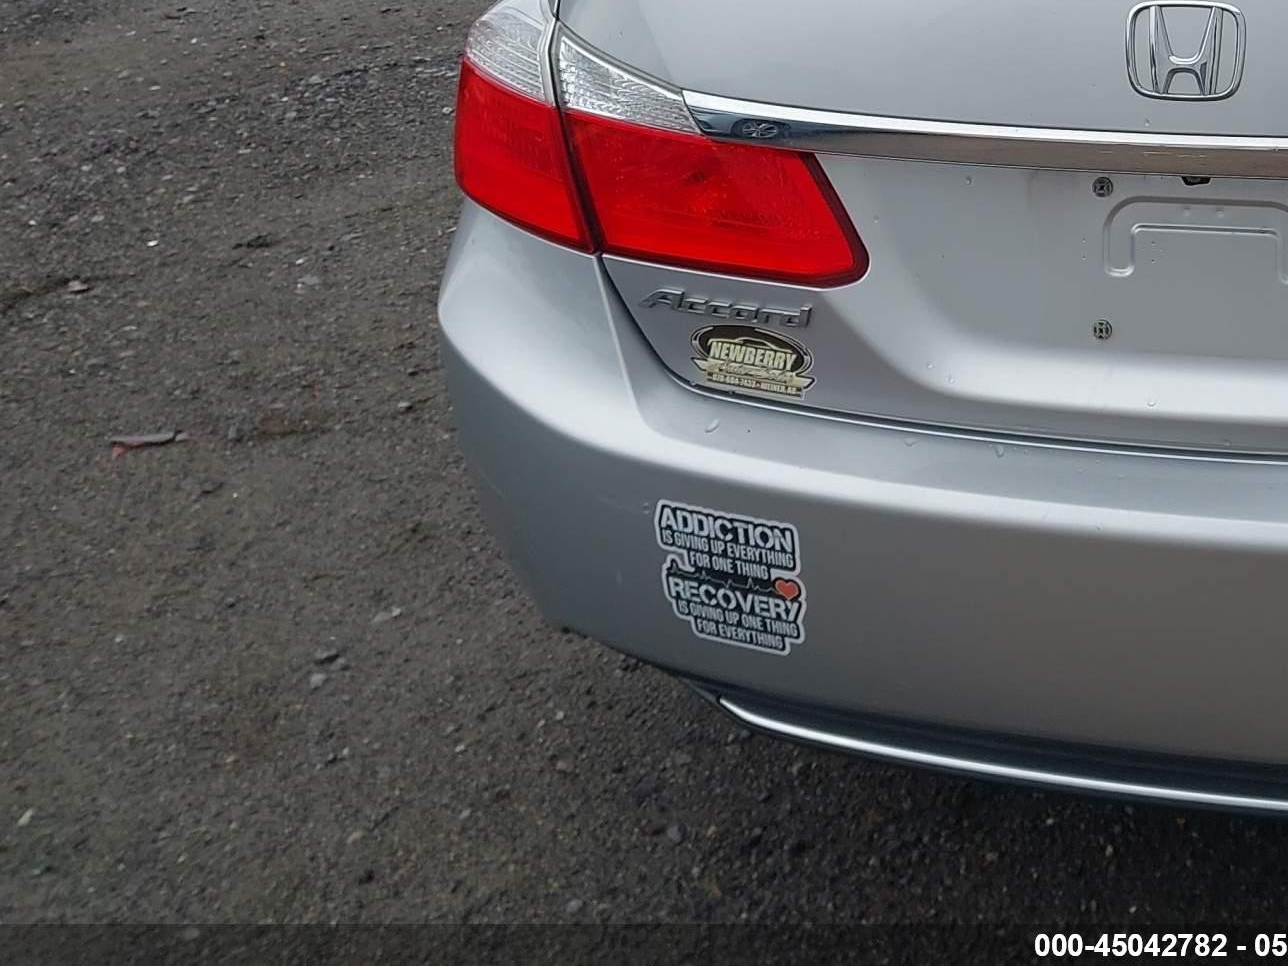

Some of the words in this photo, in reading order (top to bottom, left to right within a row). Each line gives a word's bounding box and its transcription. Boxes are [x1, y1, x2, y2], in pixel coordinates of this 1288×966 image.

[641, 287, 813, 328] Accord
[709, 341, 798, 371] NEWBERRY
[661, 507, 793, 552] ADDICTION
[662, 529, 673, 545] IS
[674, 531, 709, 552] GIVING
[710, 539, 725, 554] UP
[727, 542, 794, 568] EVERYTHING
[690, 551, 710, 569] FOR
[712, 555, 734, 573] ONE
[735, 560, 768, 580] THING
[668, 576, 799, 621] RECOVERY
[678, 599, 689, 614] IS
[690, 602, 724, 622] GIVING
[725, 609, 740, 625] UP
[741, 613, 764, 631] ONE
[765, 618, 798, 637] THING
[697, 618, 717, 635] FOR
[718, 624, 783, 649] EVERYTHING
